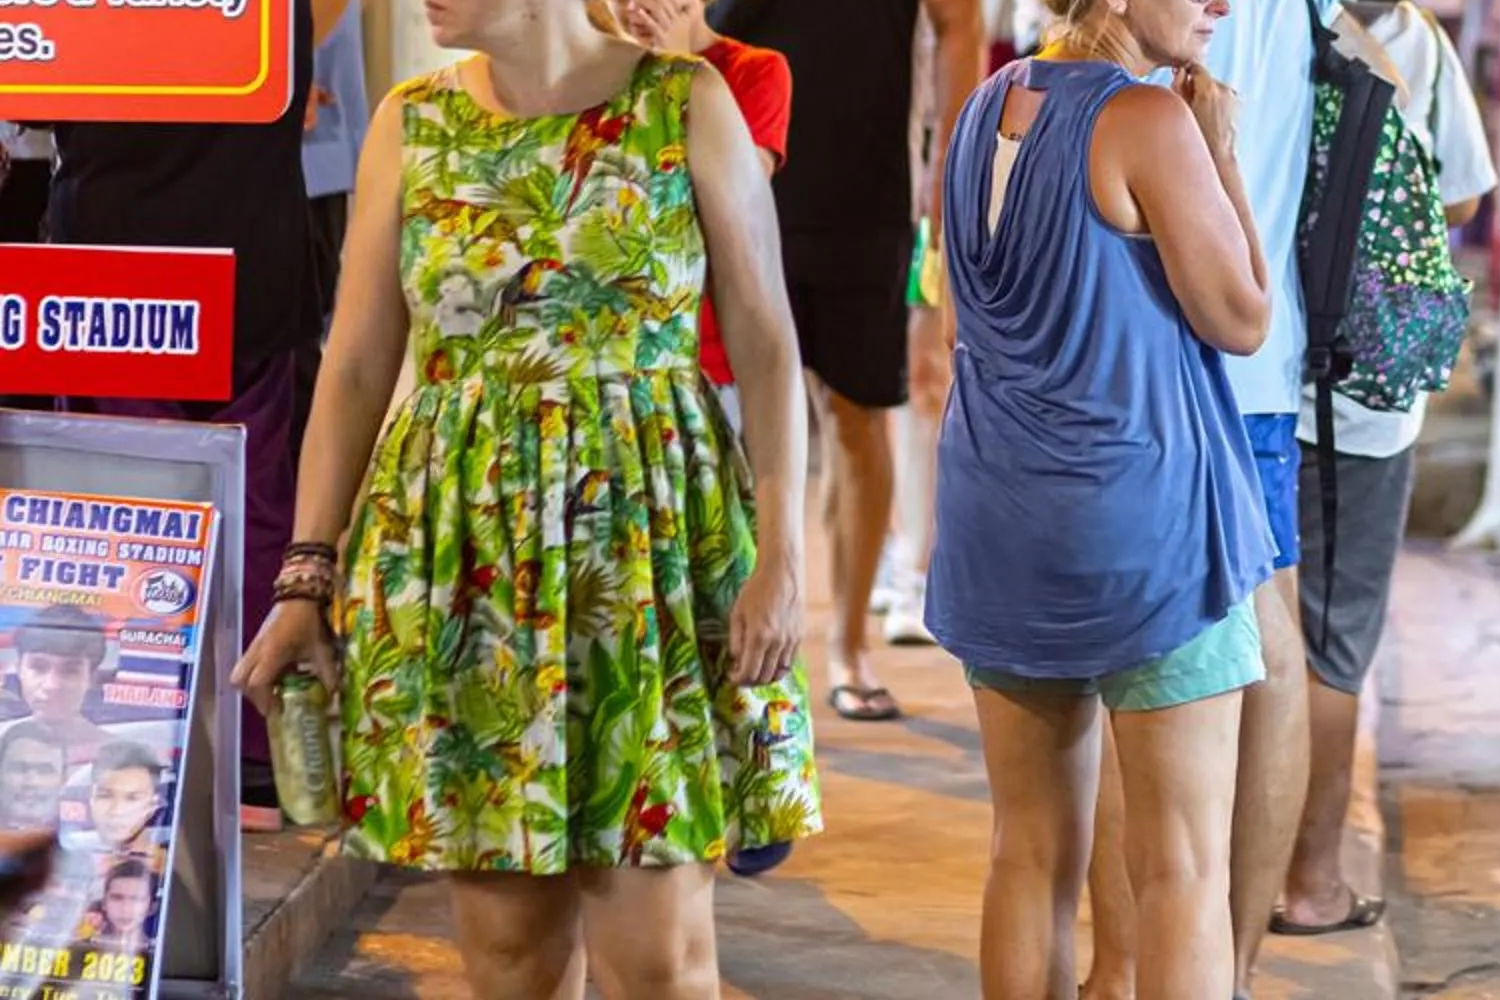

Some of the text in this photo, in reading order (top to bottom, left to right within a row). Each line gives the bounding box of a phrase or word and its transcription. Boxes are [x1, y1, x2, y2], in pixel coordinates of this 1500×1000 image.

[0, 26, 50, 55] es.
[42, 298, 196, 350] STADIUM
[6, 495, 200, 540] CHIANGMAI
[42, 535, 108, 557] BOXING
[118, 543, 202, 564] STADIUM
[20, 557, 125, 588] FIGHT
[82, 951, 145, 985] 2023
